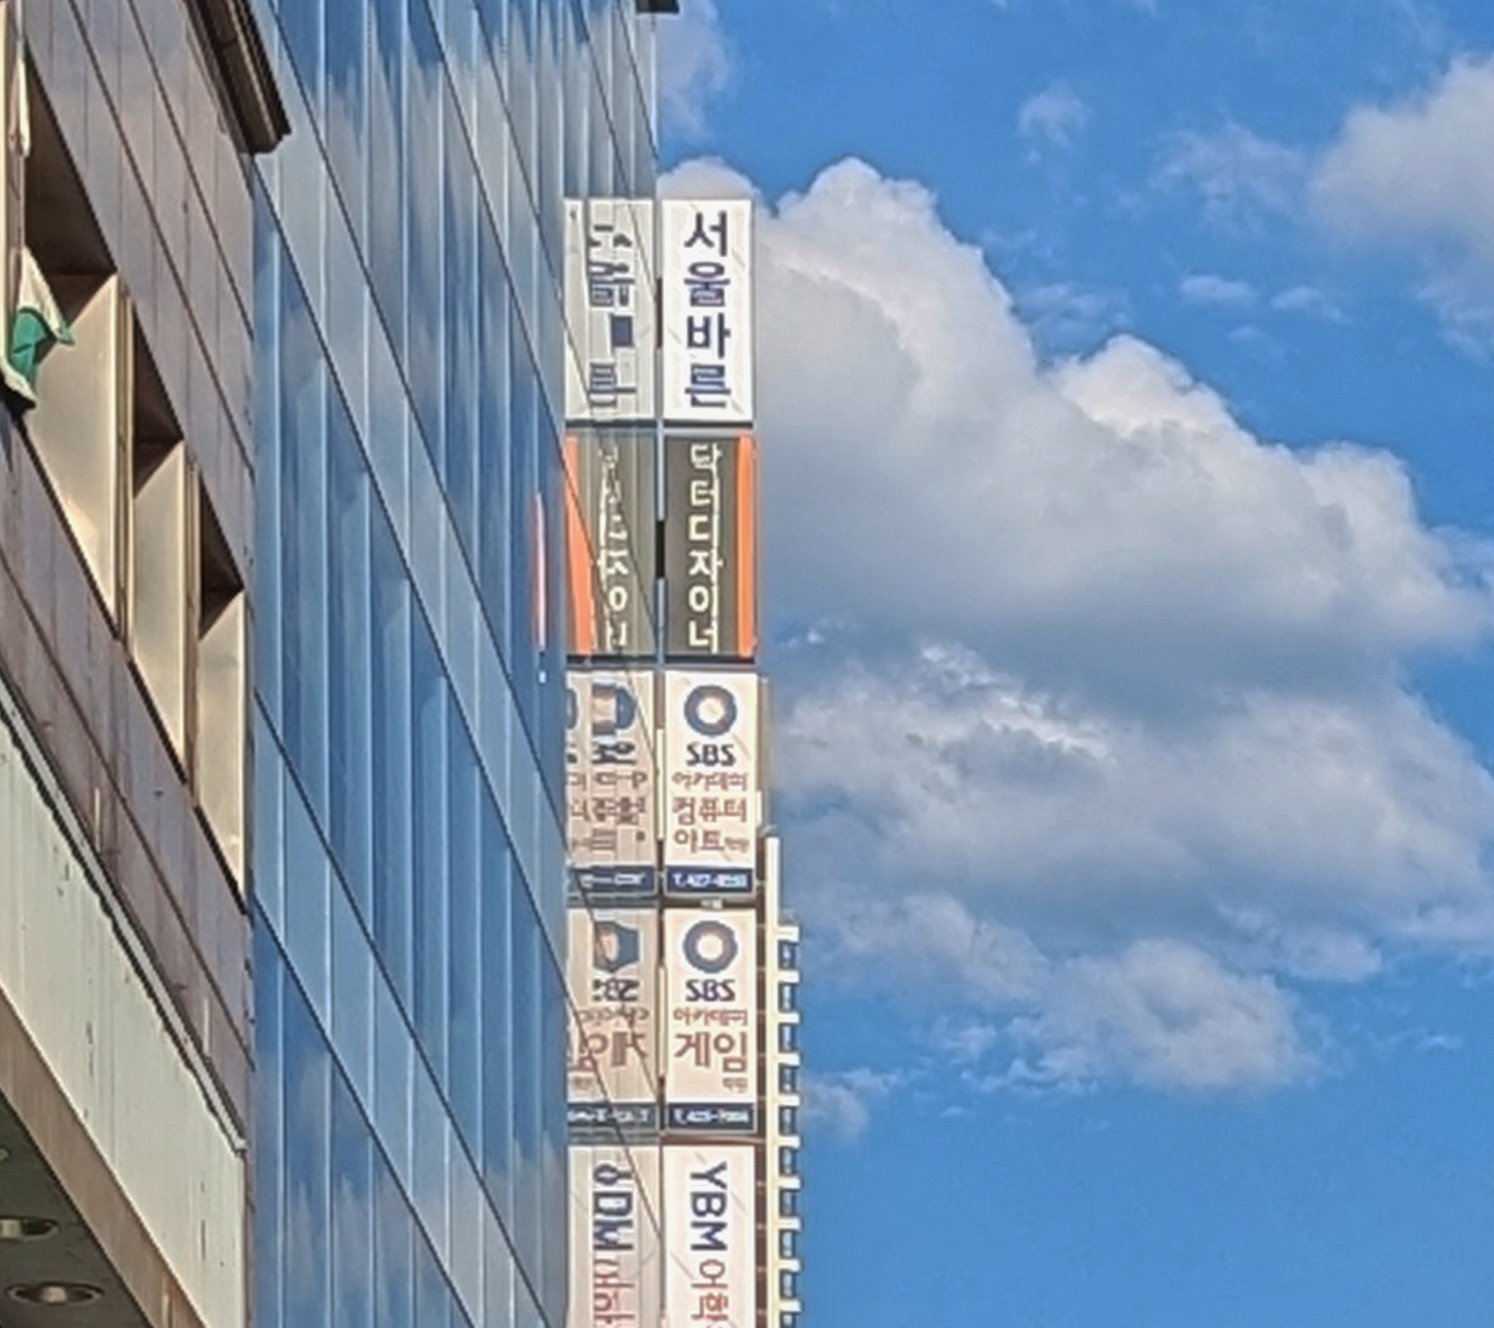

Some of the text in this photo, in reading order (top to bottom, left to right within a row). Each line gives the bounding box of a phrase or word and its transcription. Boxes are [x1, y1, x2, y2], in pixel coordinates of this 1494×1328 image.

[684, 210, 731, 408] 서울바른
[687, 742, 735, 766] SBS
[685, 978, 736, 1001] SBS
[674, 1031, 748, 1073] 게임
[690, 1160, 727, 1252] YBM
